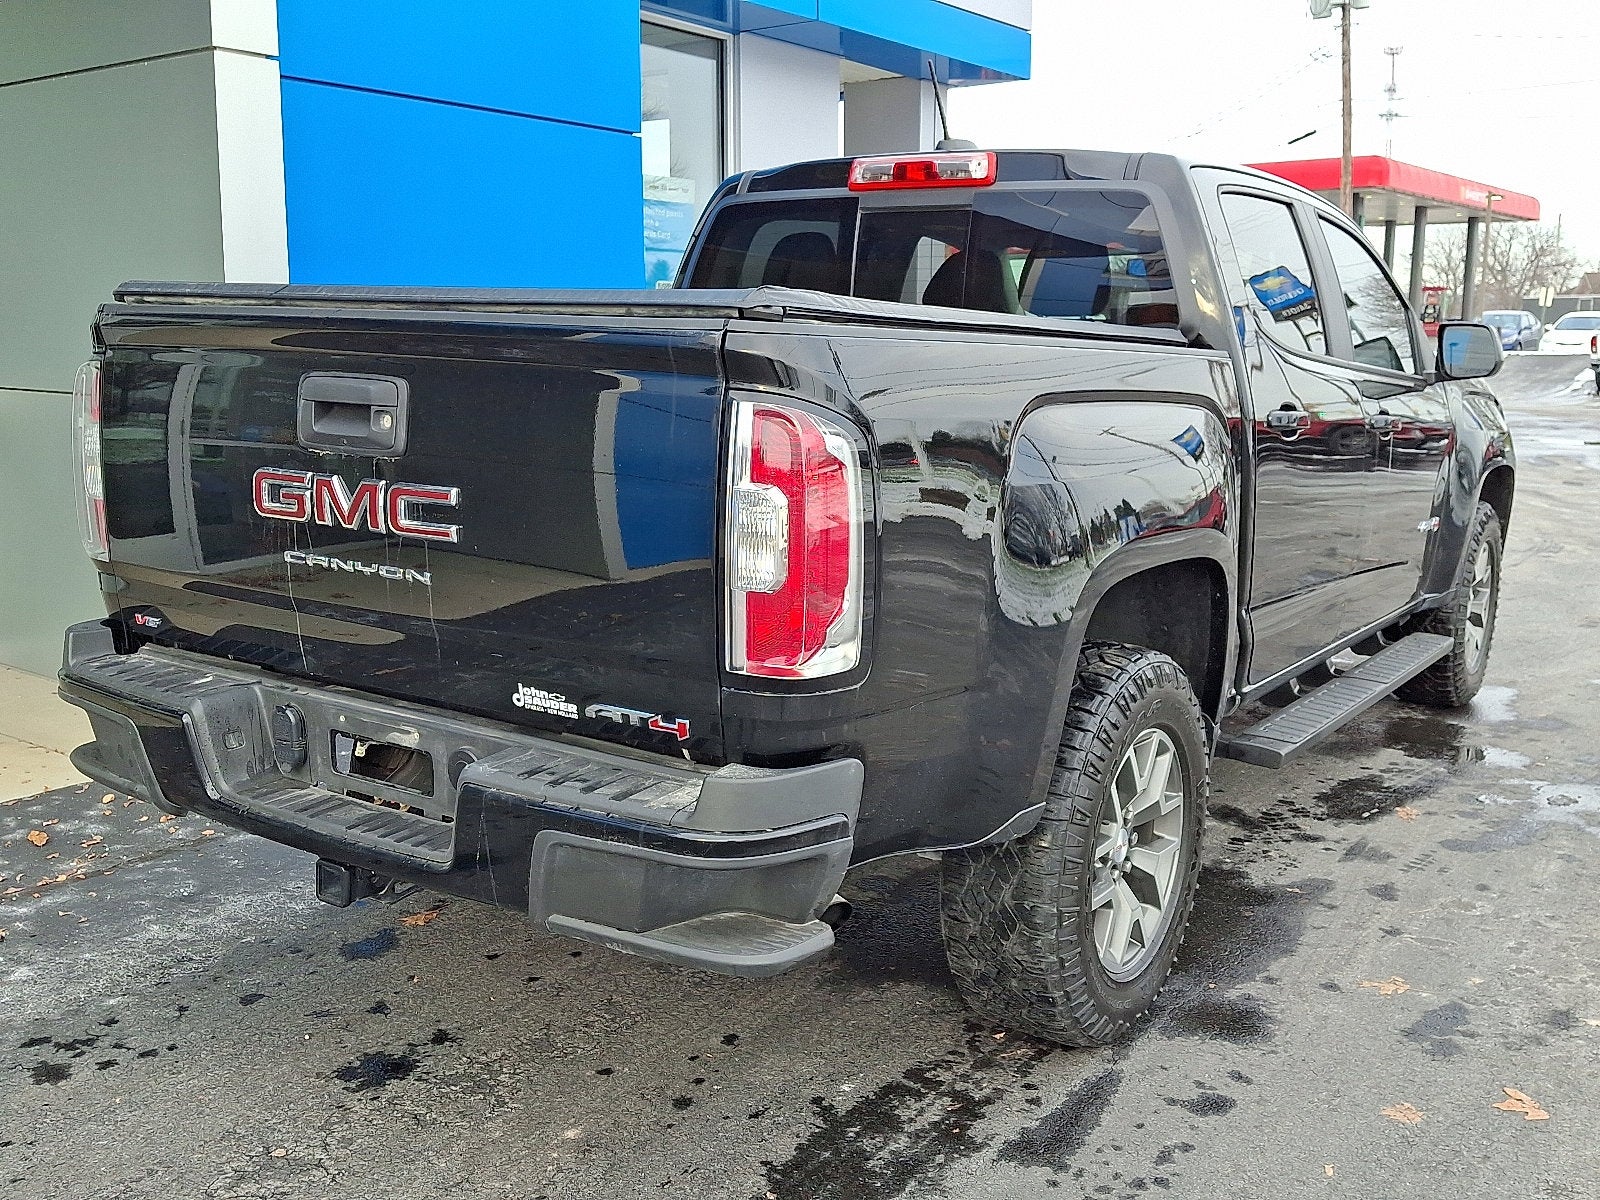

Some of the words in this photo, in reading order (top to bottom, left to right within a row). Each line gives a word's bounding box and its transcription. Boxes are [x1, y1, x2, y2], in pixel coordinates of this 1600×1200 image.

[252, 466, 462, 544] GMC
[283, 550, 432, 586] CANYON
[134, 613, 162, 628] V6
[512, 682, 549, 708] John
[524, 694, 579, 714] SAUDER
[585, 703, 690, 741] AT4
